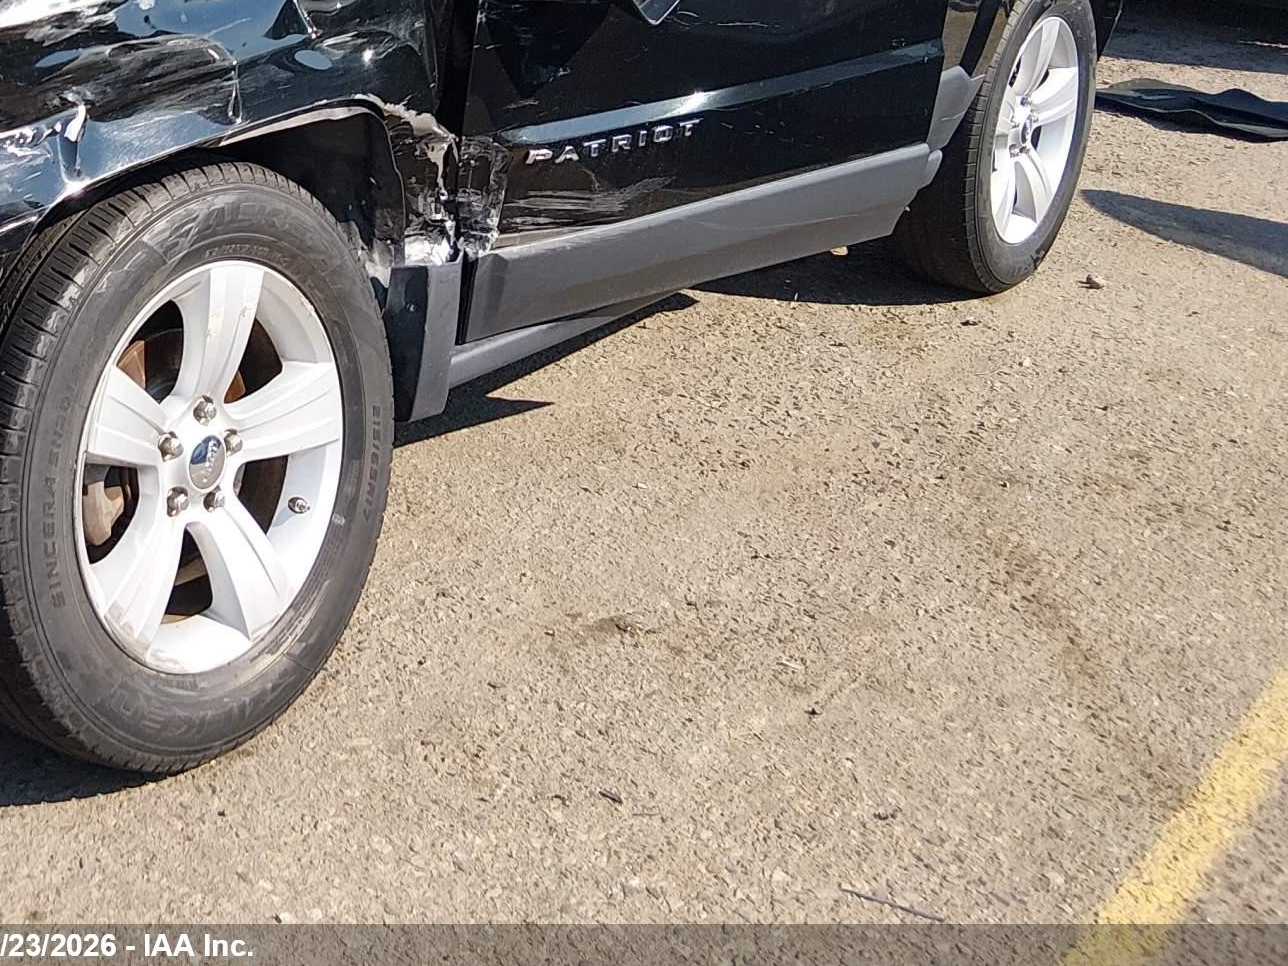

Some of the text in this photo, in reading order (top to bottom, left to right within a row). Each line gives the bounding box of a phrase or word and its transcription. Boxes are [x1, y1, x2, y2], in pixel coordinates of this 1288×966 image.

[524, 117, 704, 165] PATRIOT
[362, 404, 382, 523] 215/65R17
[41, 475, 67, 610] SINCERA
